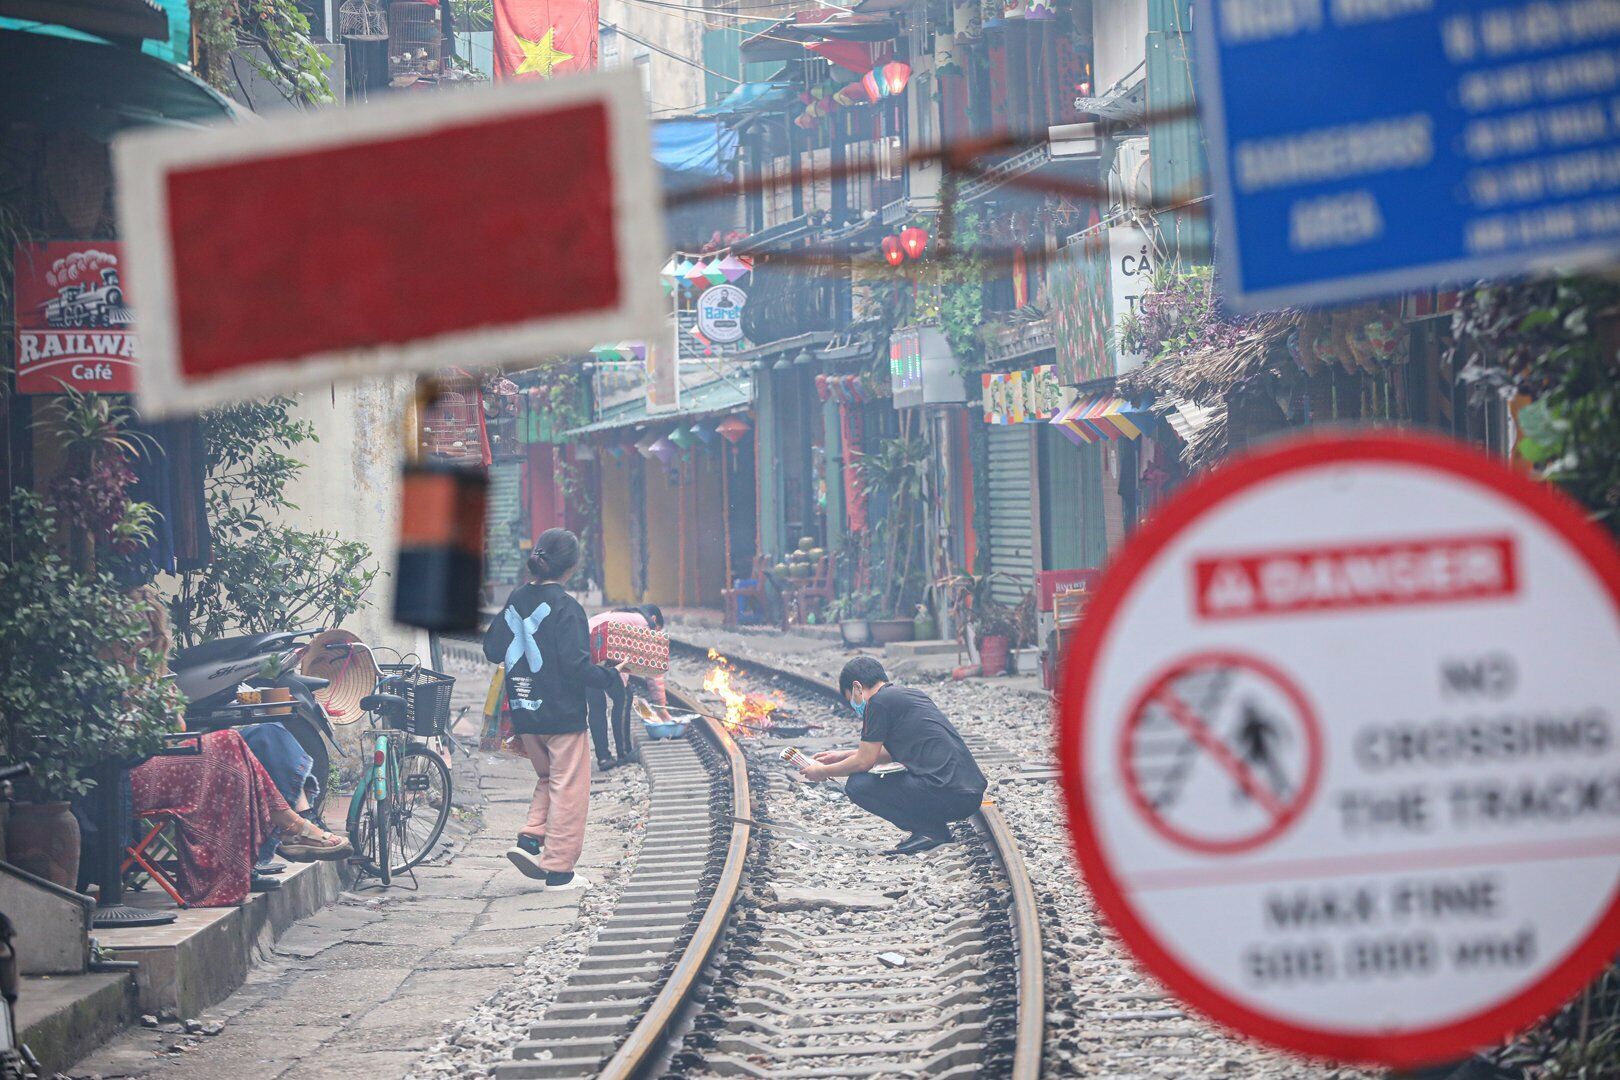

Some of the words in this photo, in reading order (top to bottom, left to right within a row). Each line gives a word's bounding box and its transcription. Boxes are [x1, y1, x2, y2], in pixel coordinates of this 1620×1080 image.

[72, 363, 112, 380] Café
[1261, 547, 1498, 603] DANGER
[1442, 656, 1516, 697] NO
[1356, 713, 1609, 768] CROSSING
[1339, 788, 1431, 833] THE
[1391, 877, 1503, 916] FINE
